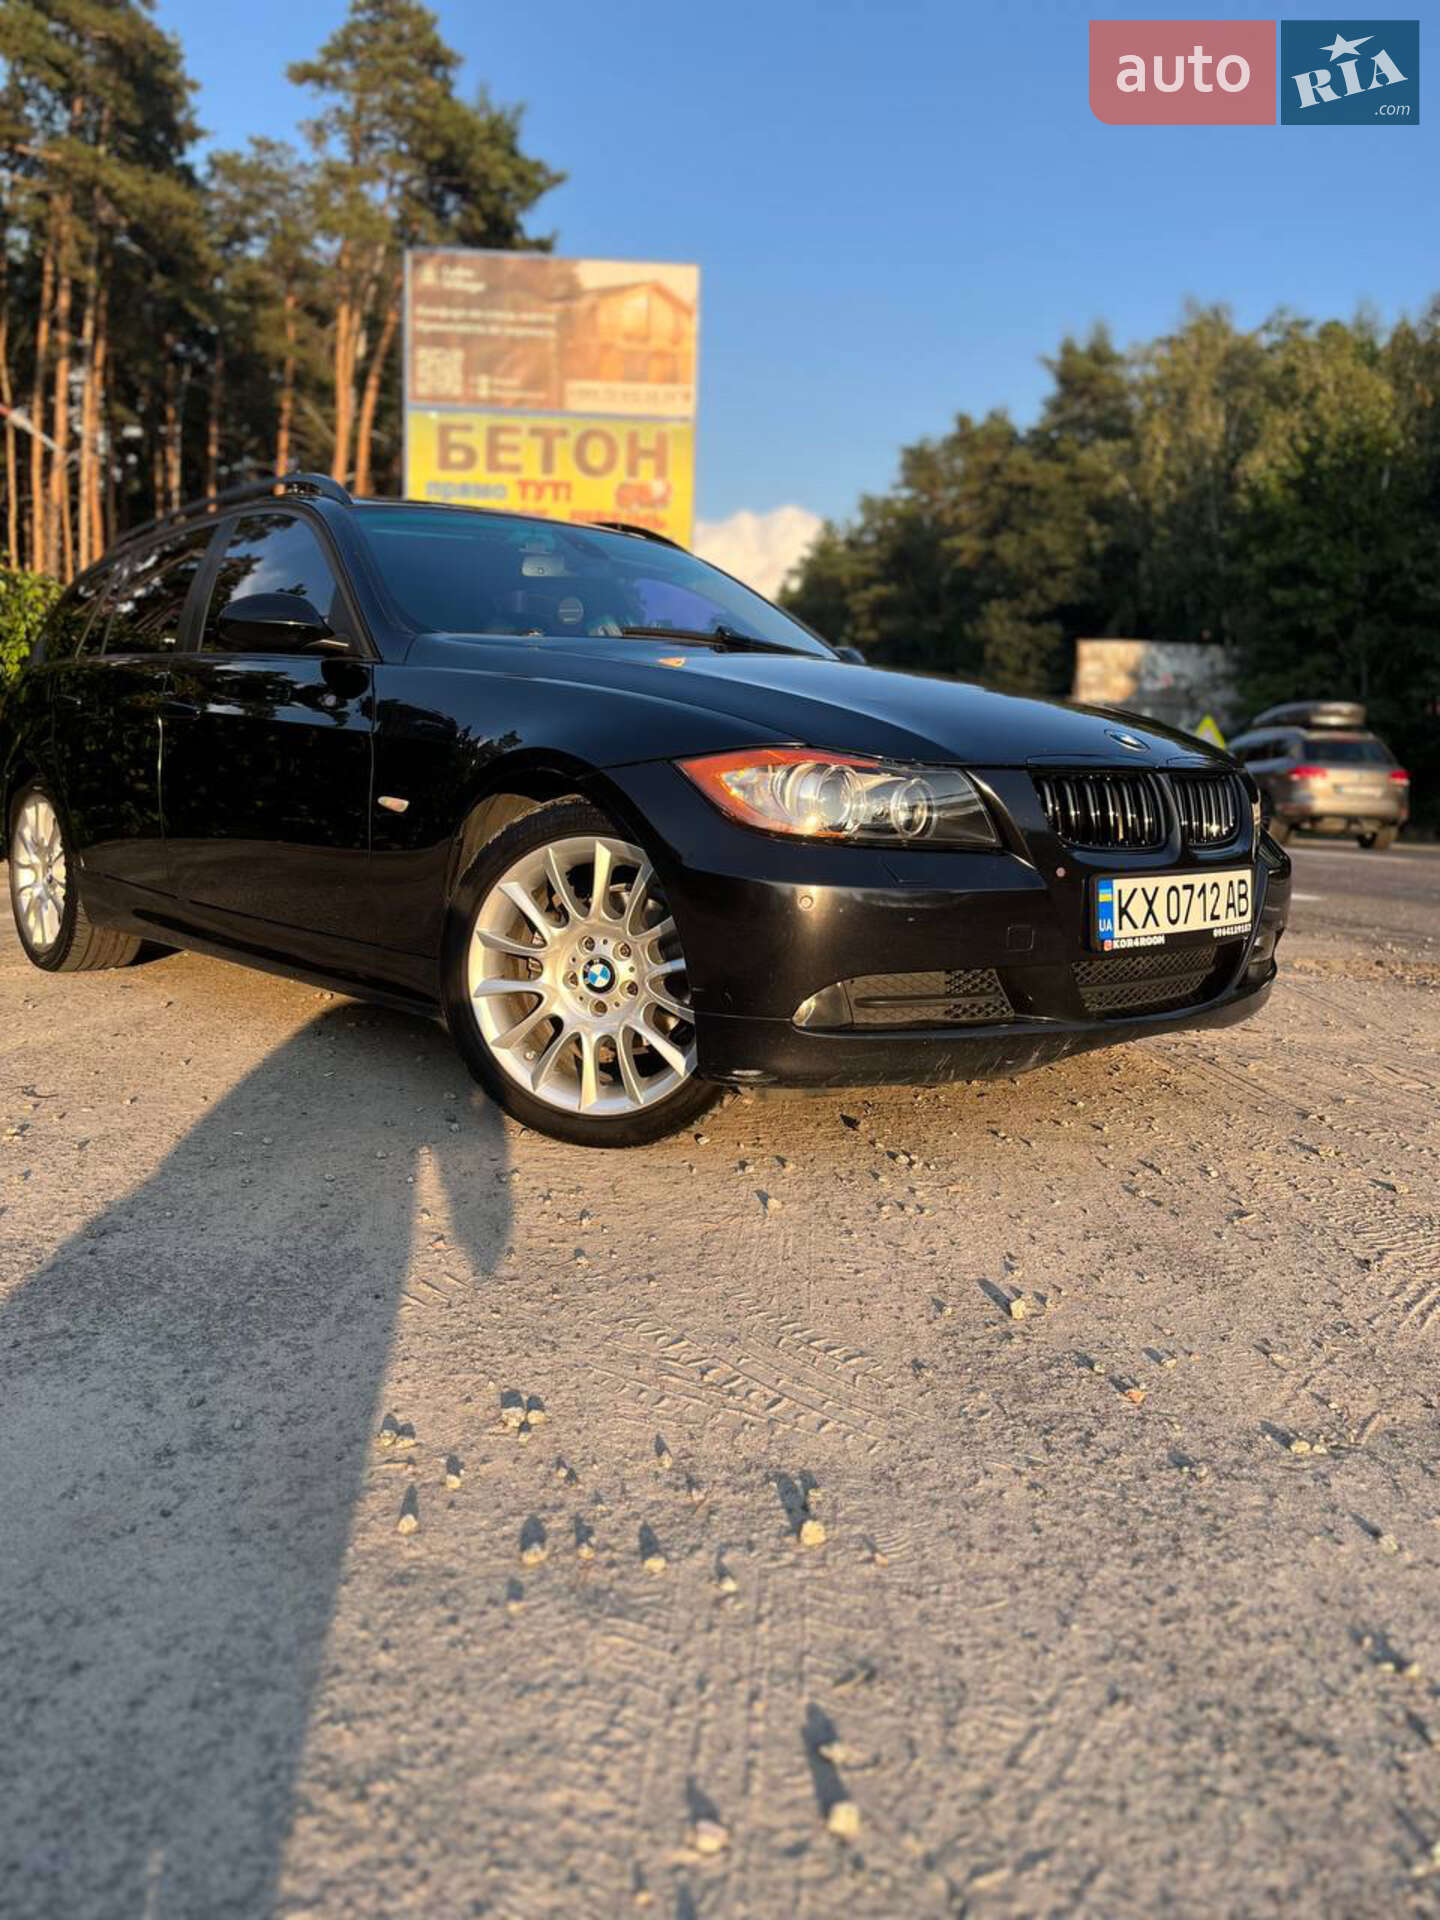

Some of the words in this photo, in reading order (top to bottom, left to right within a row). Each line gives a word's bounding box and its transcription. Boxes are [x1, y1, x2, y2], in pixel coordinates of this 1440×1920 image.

[436, 422, 669, 479] БЕТОН
[1098, 918, 1113, 932] UA
[1118, 887, 1160, 931] KX
[1166, 881, 1221, 926] 0712
[1225, 878, 1249, 919] AB
